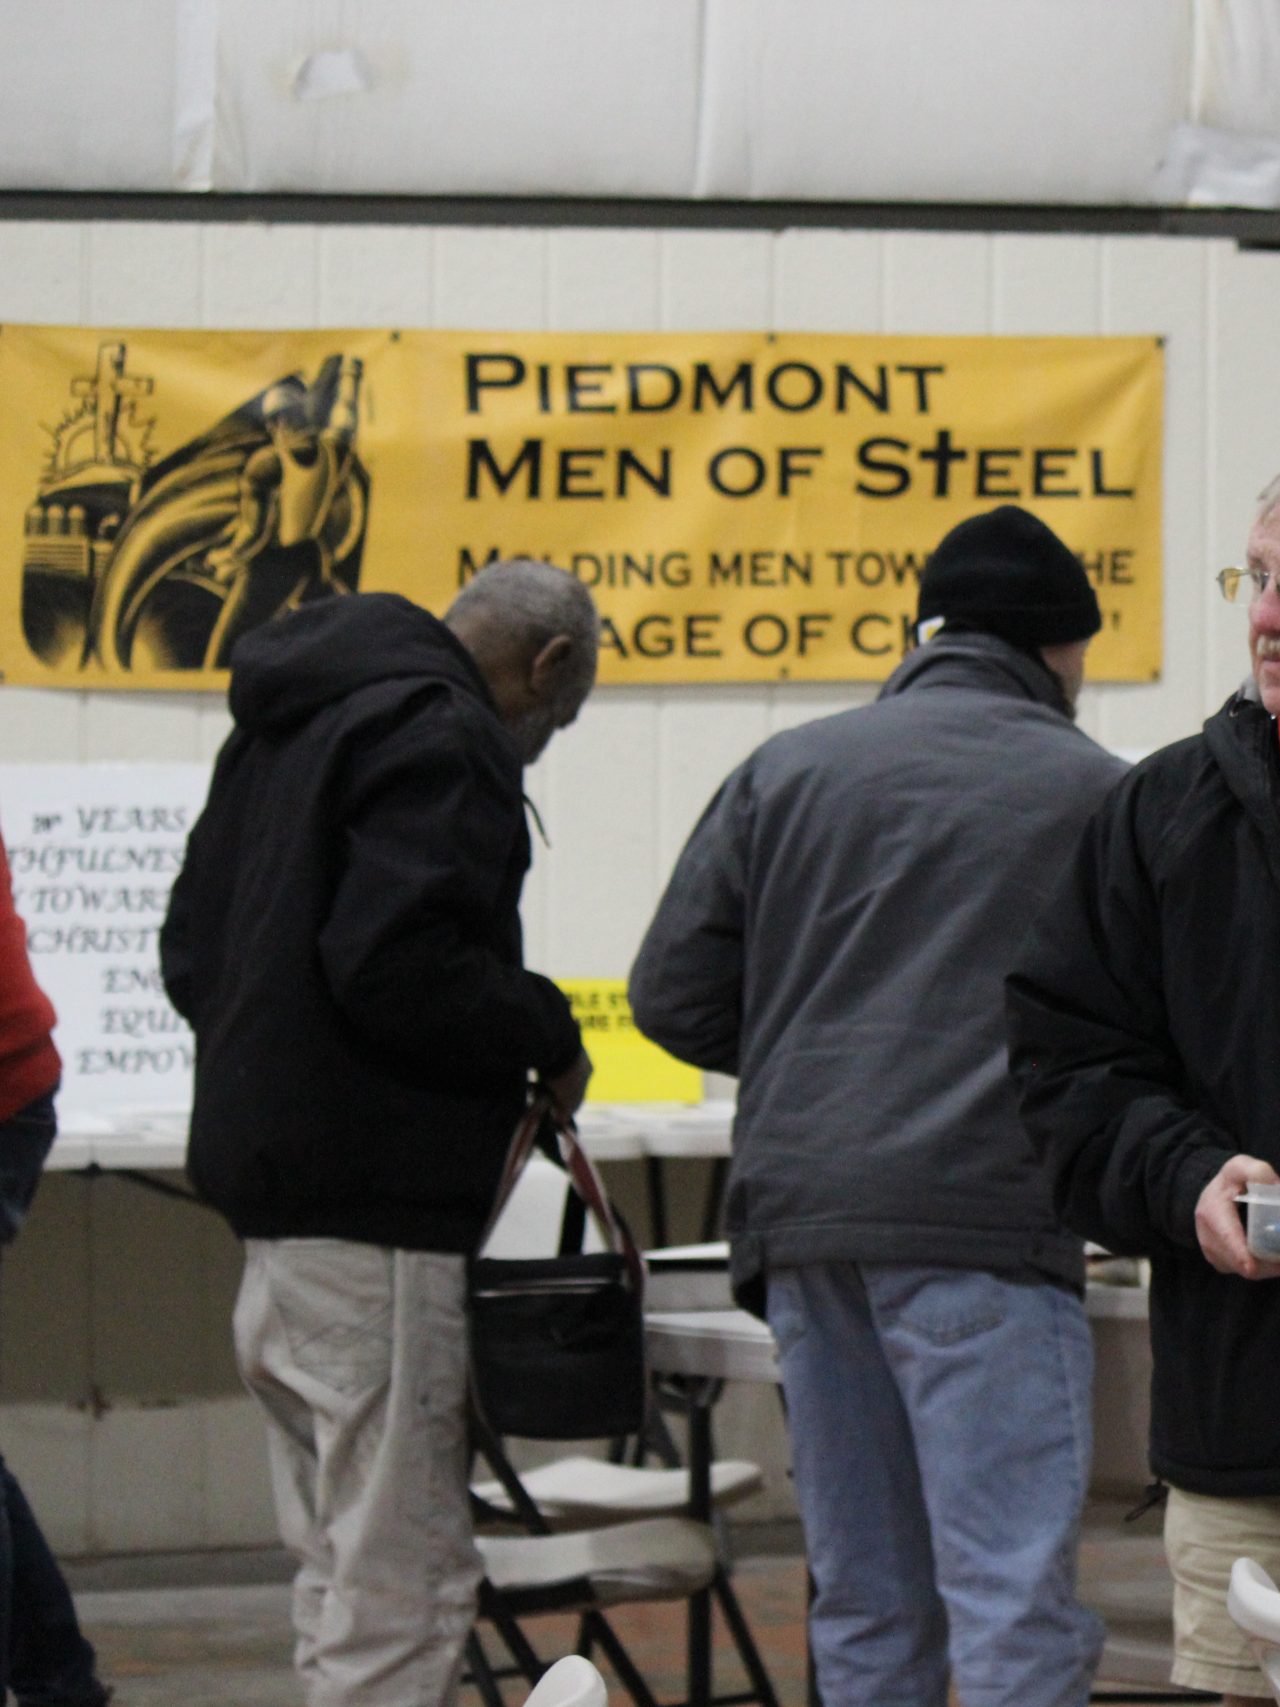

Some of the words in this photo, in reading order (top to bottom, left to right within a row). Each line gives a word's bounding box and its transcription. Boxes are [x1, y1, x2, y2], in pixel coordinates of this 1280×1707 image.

[465, 353, 945, 414] PIEDMONT
[466, 437, 672, 500] MEN
[708, 446, 823, 498] OF
[854, 429, 1136, 499] STEEL
[457, 546, 692, 588] MDING
[708, 550, 814, 588] MEN
[828, 549, 925, 587] TOW
[1077, 549, 1136, 585] HE
[598, 612, 723, 659] AGE
[743, 612, 833, 658] OF
[33, 883, 172, 914] TOWAR
